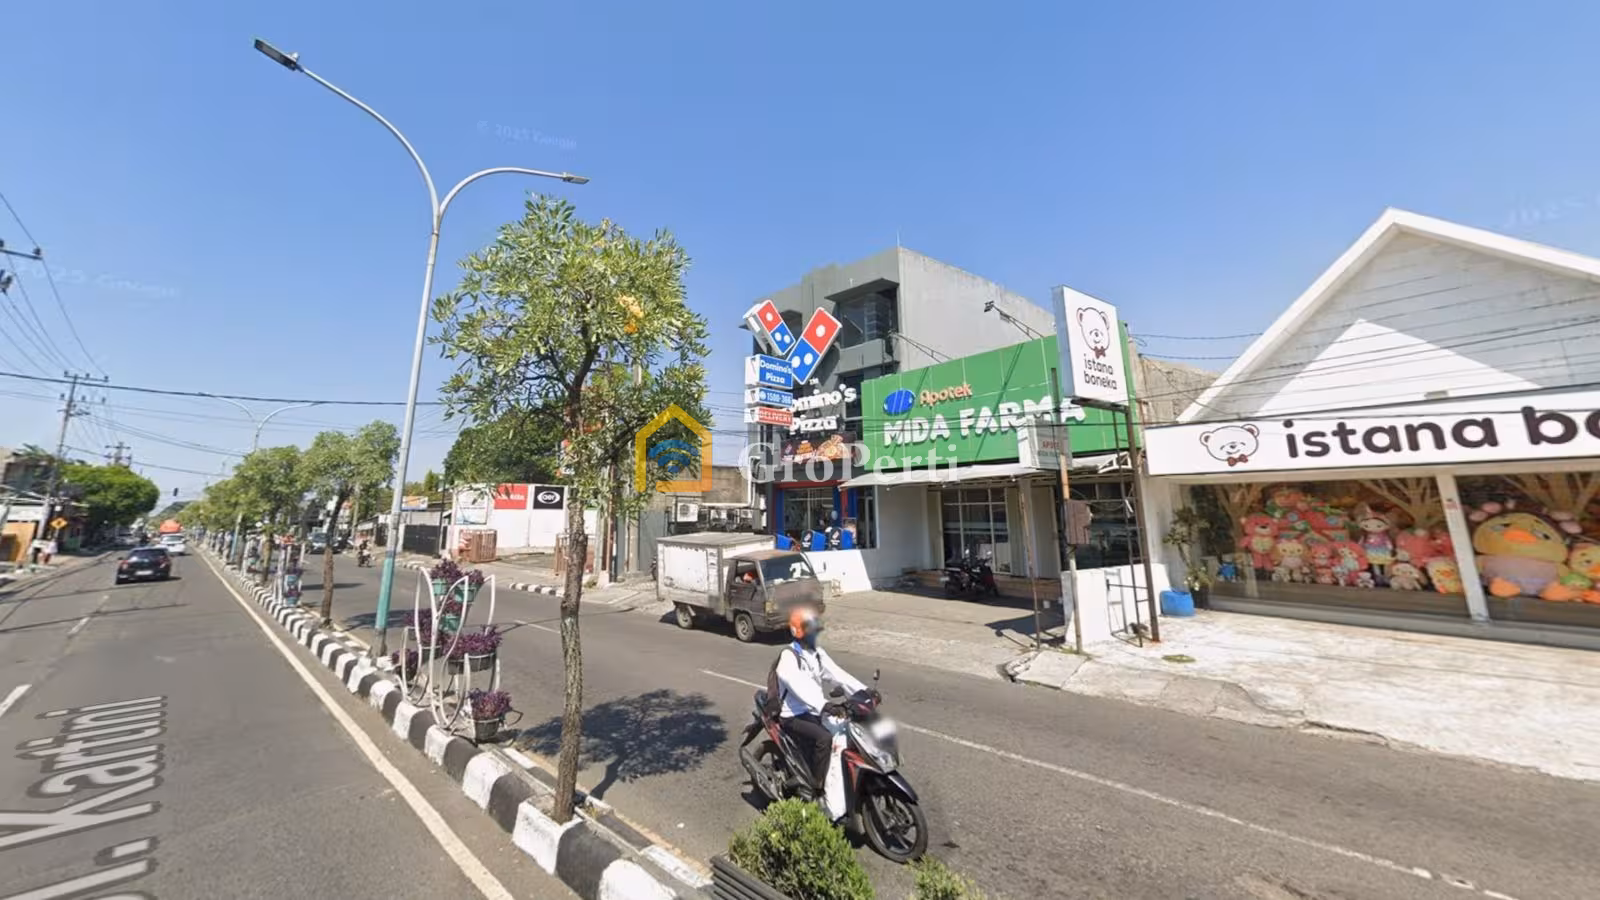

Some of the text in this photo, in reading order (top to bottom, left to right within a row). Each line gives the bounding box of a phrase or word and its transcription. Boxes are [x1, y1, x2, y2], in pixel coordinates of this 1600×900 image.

[760, 359, 793, 375] Domino's
[1084, 353, 1113, 376] istana
[765, 372, 786, 384] Pizza
[1083, 370, 1118, 390] boneka
[789, 383, 858, 412] omino's
[919, 383, 974, 406] Apotek
[759, 408, 793, 423] DELIVERY
[883, 413, 951, 447] MIDA
[1282, 419, 1499, 459] istana
